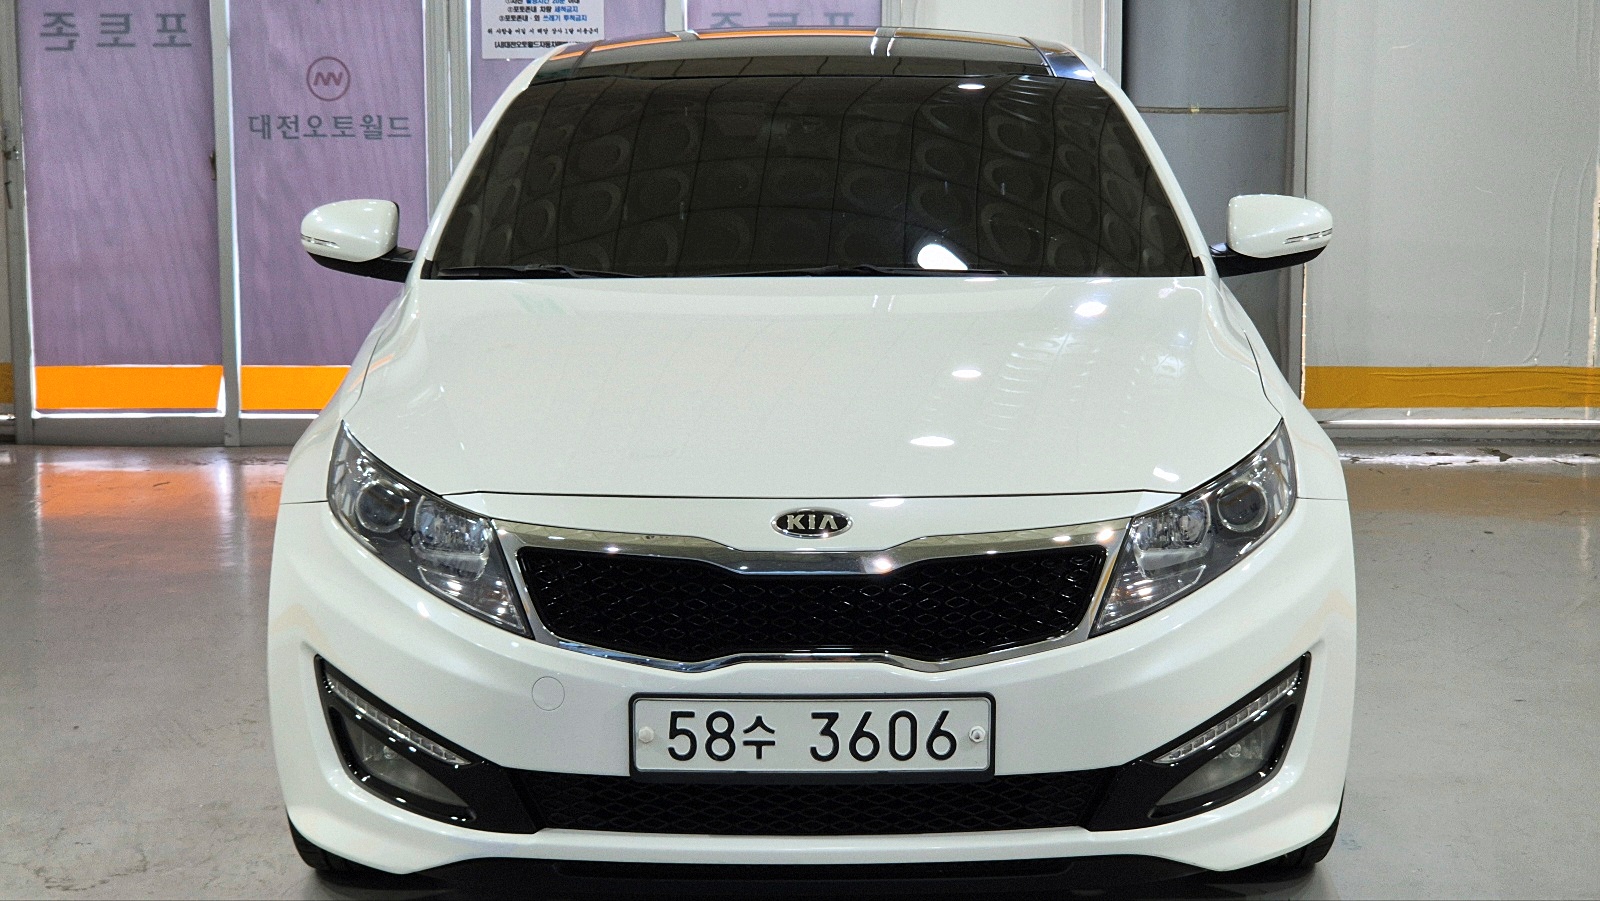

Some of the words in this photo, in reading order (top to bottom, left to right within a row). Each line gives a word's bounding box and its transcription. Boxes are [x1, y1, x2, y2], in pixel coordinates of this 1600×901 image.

[248, 114, 411, 140] 대전오토월드
[786, 514, 838, 530] KIA
[667, 710, 775, 762] 58수
[809, 709, 957, 762] 3606
